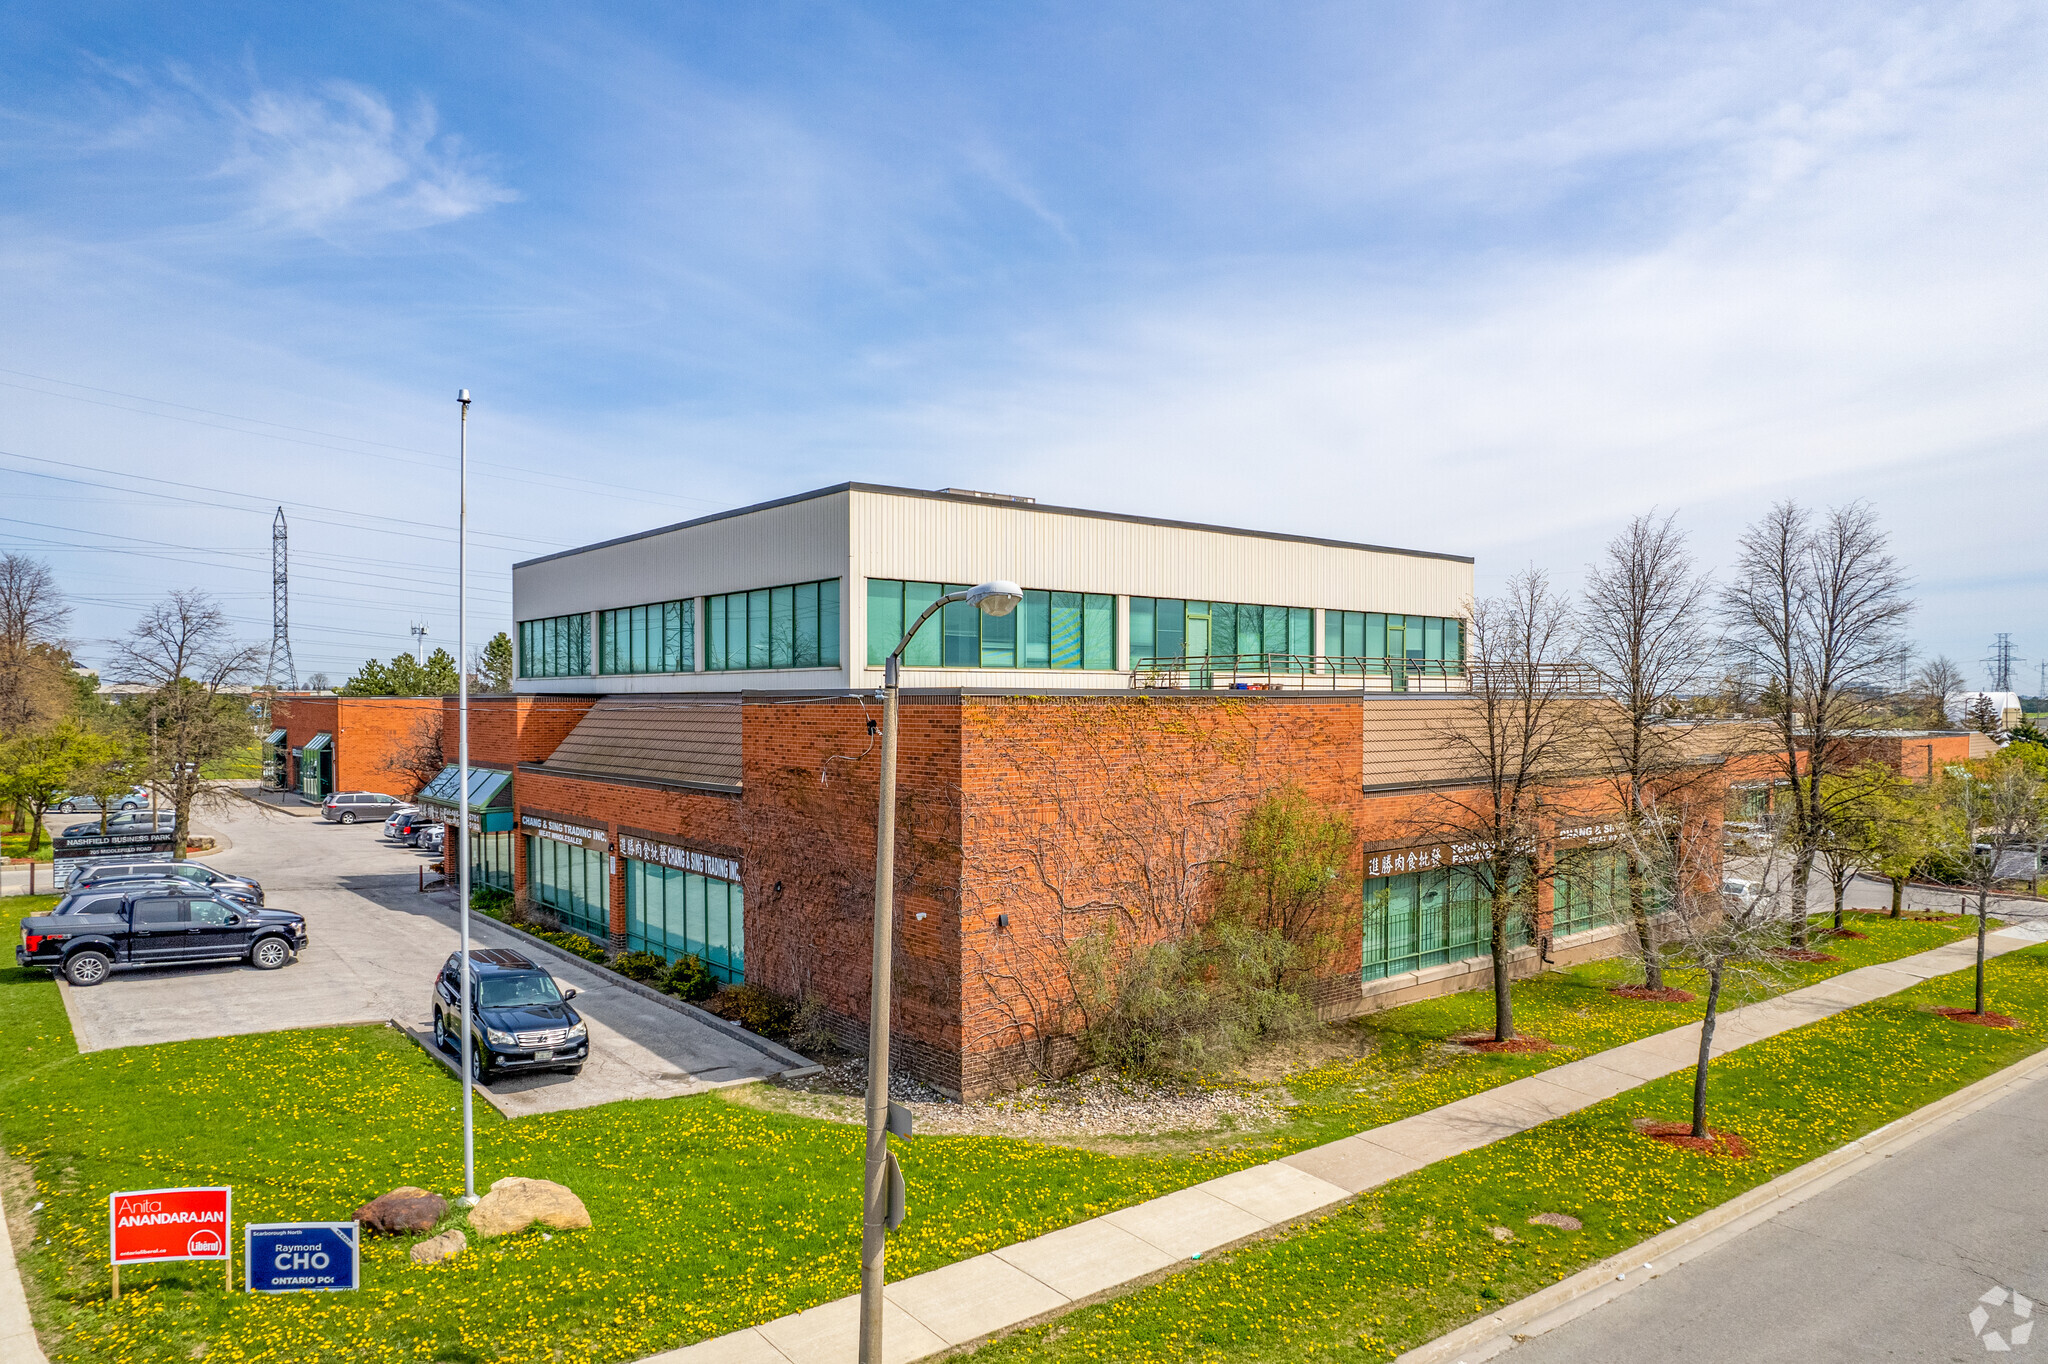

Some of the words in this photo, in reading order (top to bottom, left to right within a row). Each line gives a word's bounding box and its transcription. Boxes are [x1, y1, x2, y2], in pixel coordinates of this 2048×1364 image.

[522, 816, 541, 827] CHANG
[543, 820, 547, 829] &
[548, 821, 563, 832] SING
[564, 824, 592, 838] TRADING
[593, 830, 606, 842] INC.
[66, 838, 110, 846] NASHFIELD
[552, 833, 582, 845] WHOLESALER
[668, 847, 685, 868] CHANG
[686, 851, 690, 869] &
[691, 852, 704, 872] SING
[704, 855, 728, 878] TRADING
[118, 1199, 161, 1214] Anita
[118, 1211, 224, 1228] ANANDARAJAN
[275, 1243, 322, 1252] Raymond
[275, 1252, 330, 1270] CHO
[271, 1276, 316, 1285] ONTARIO
